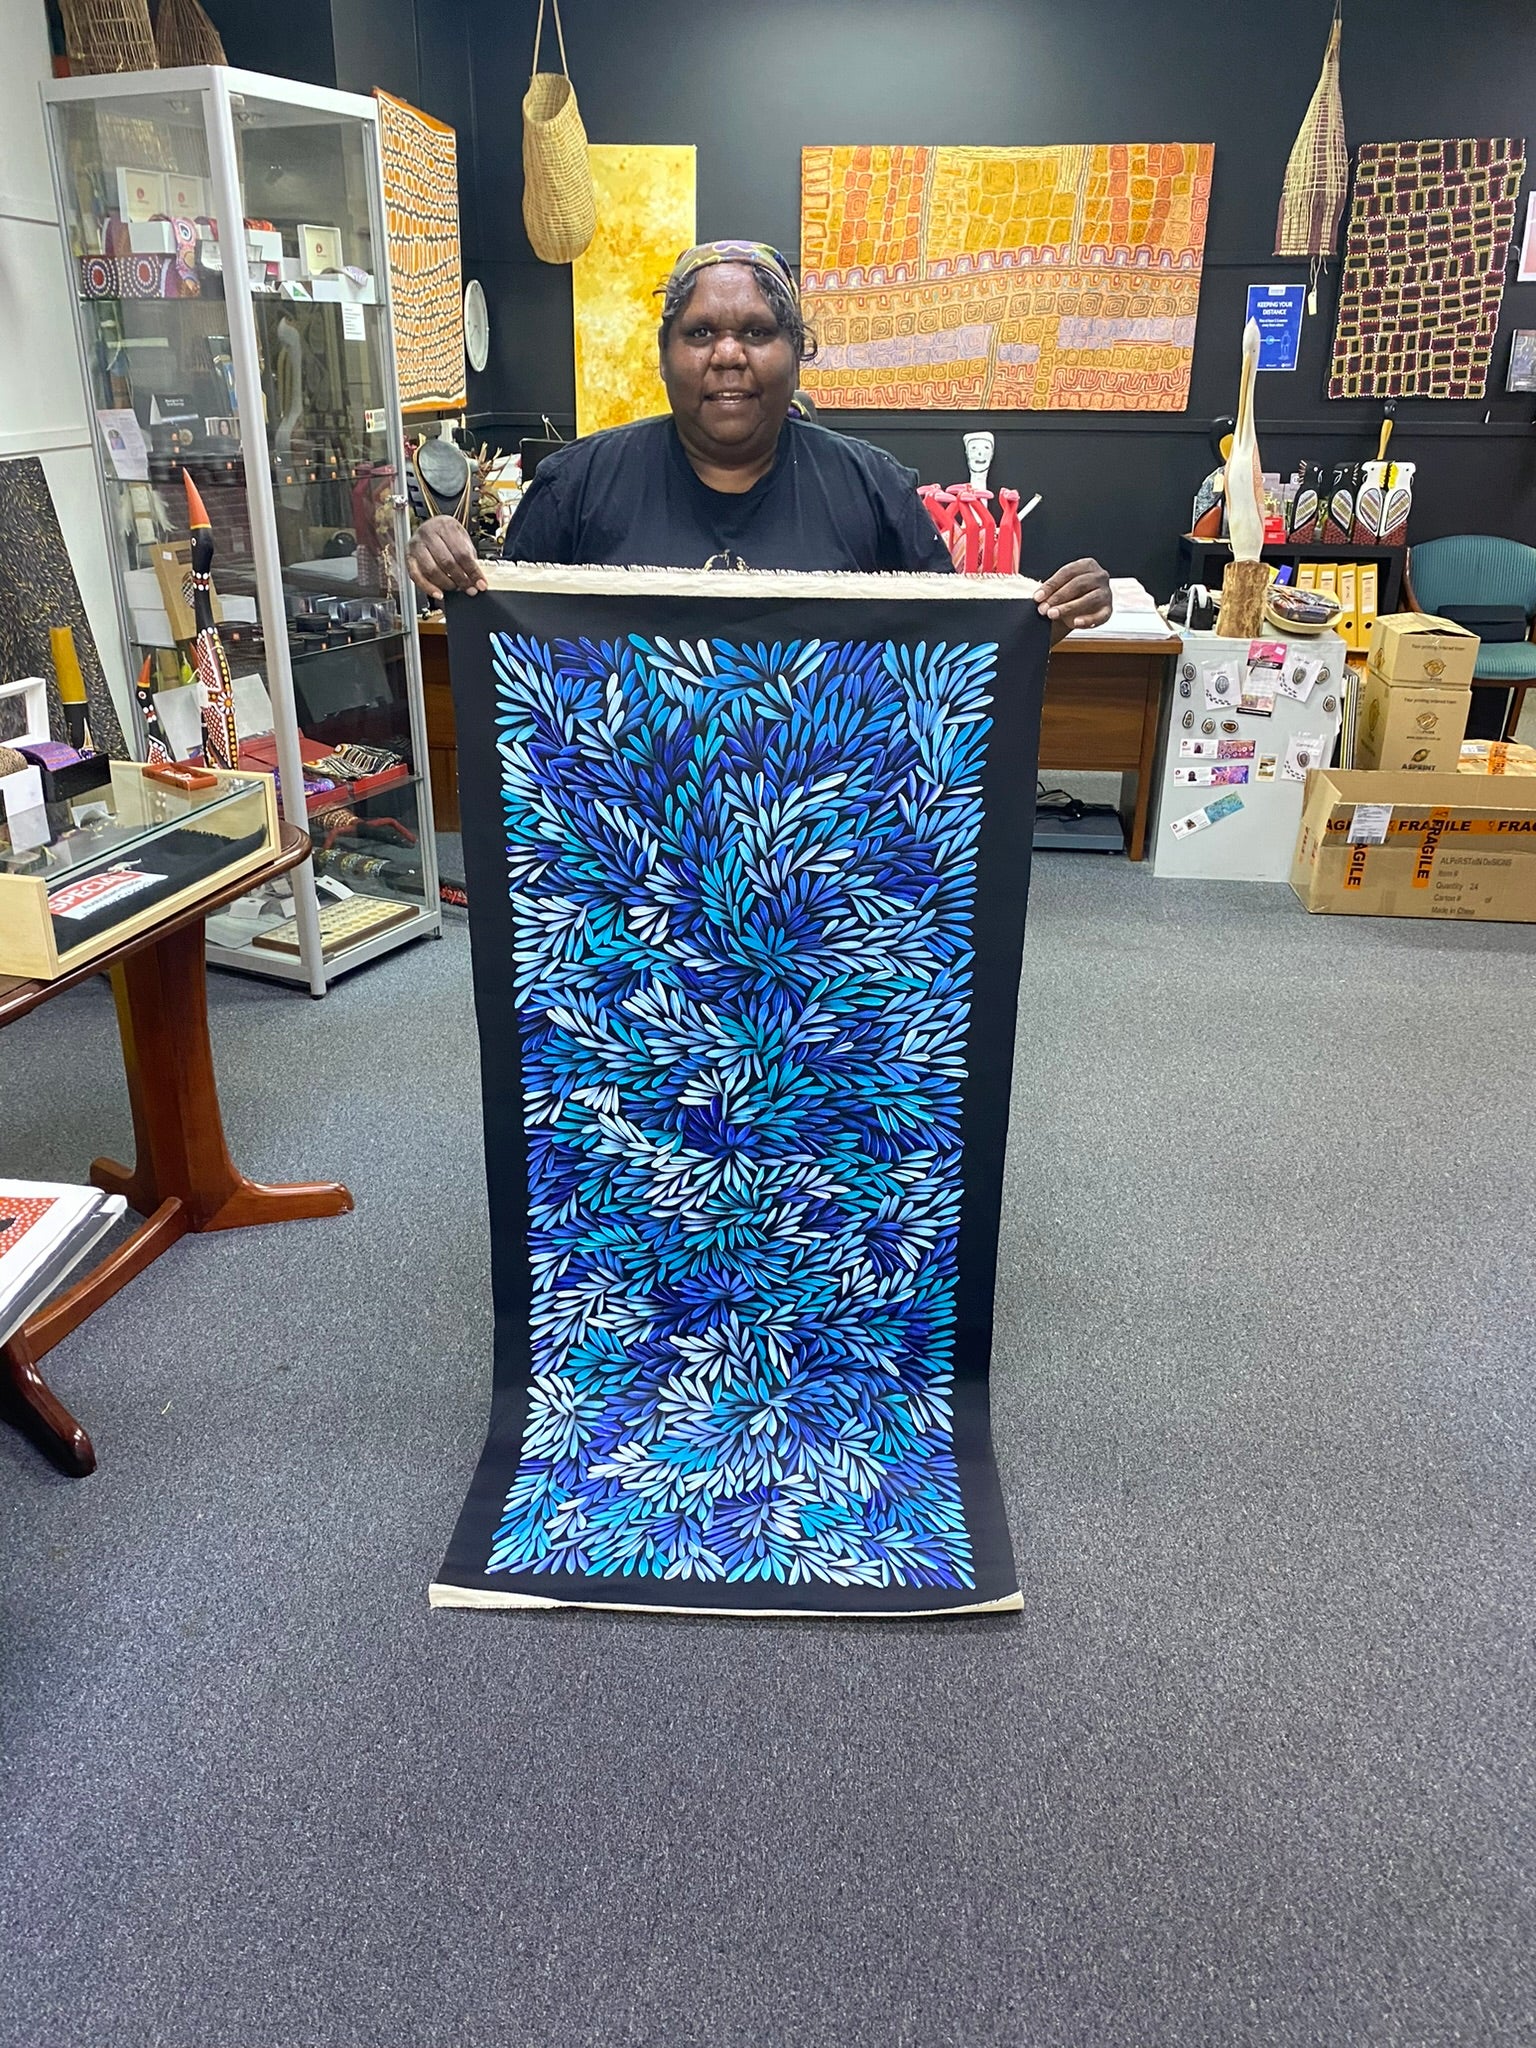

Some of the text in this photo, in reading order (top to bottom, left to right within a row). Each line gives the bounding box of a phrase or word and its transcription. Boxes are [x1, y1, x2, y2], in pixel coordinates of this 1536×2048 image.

[1401, 763, 1436, 771] ASPRINT
[1399, 819, 1472, 832] FRAILE
[1417, 819, 1443, 879] FRAGILE
[1348, 843, 1367, 886] AGILE
[48, 874, 132, 911] SPECIAL
[1436, 881, 1463, 891] Quantity
[1431, 906, 1448, 914] Made
[1457, 907, 1476, 915] China
